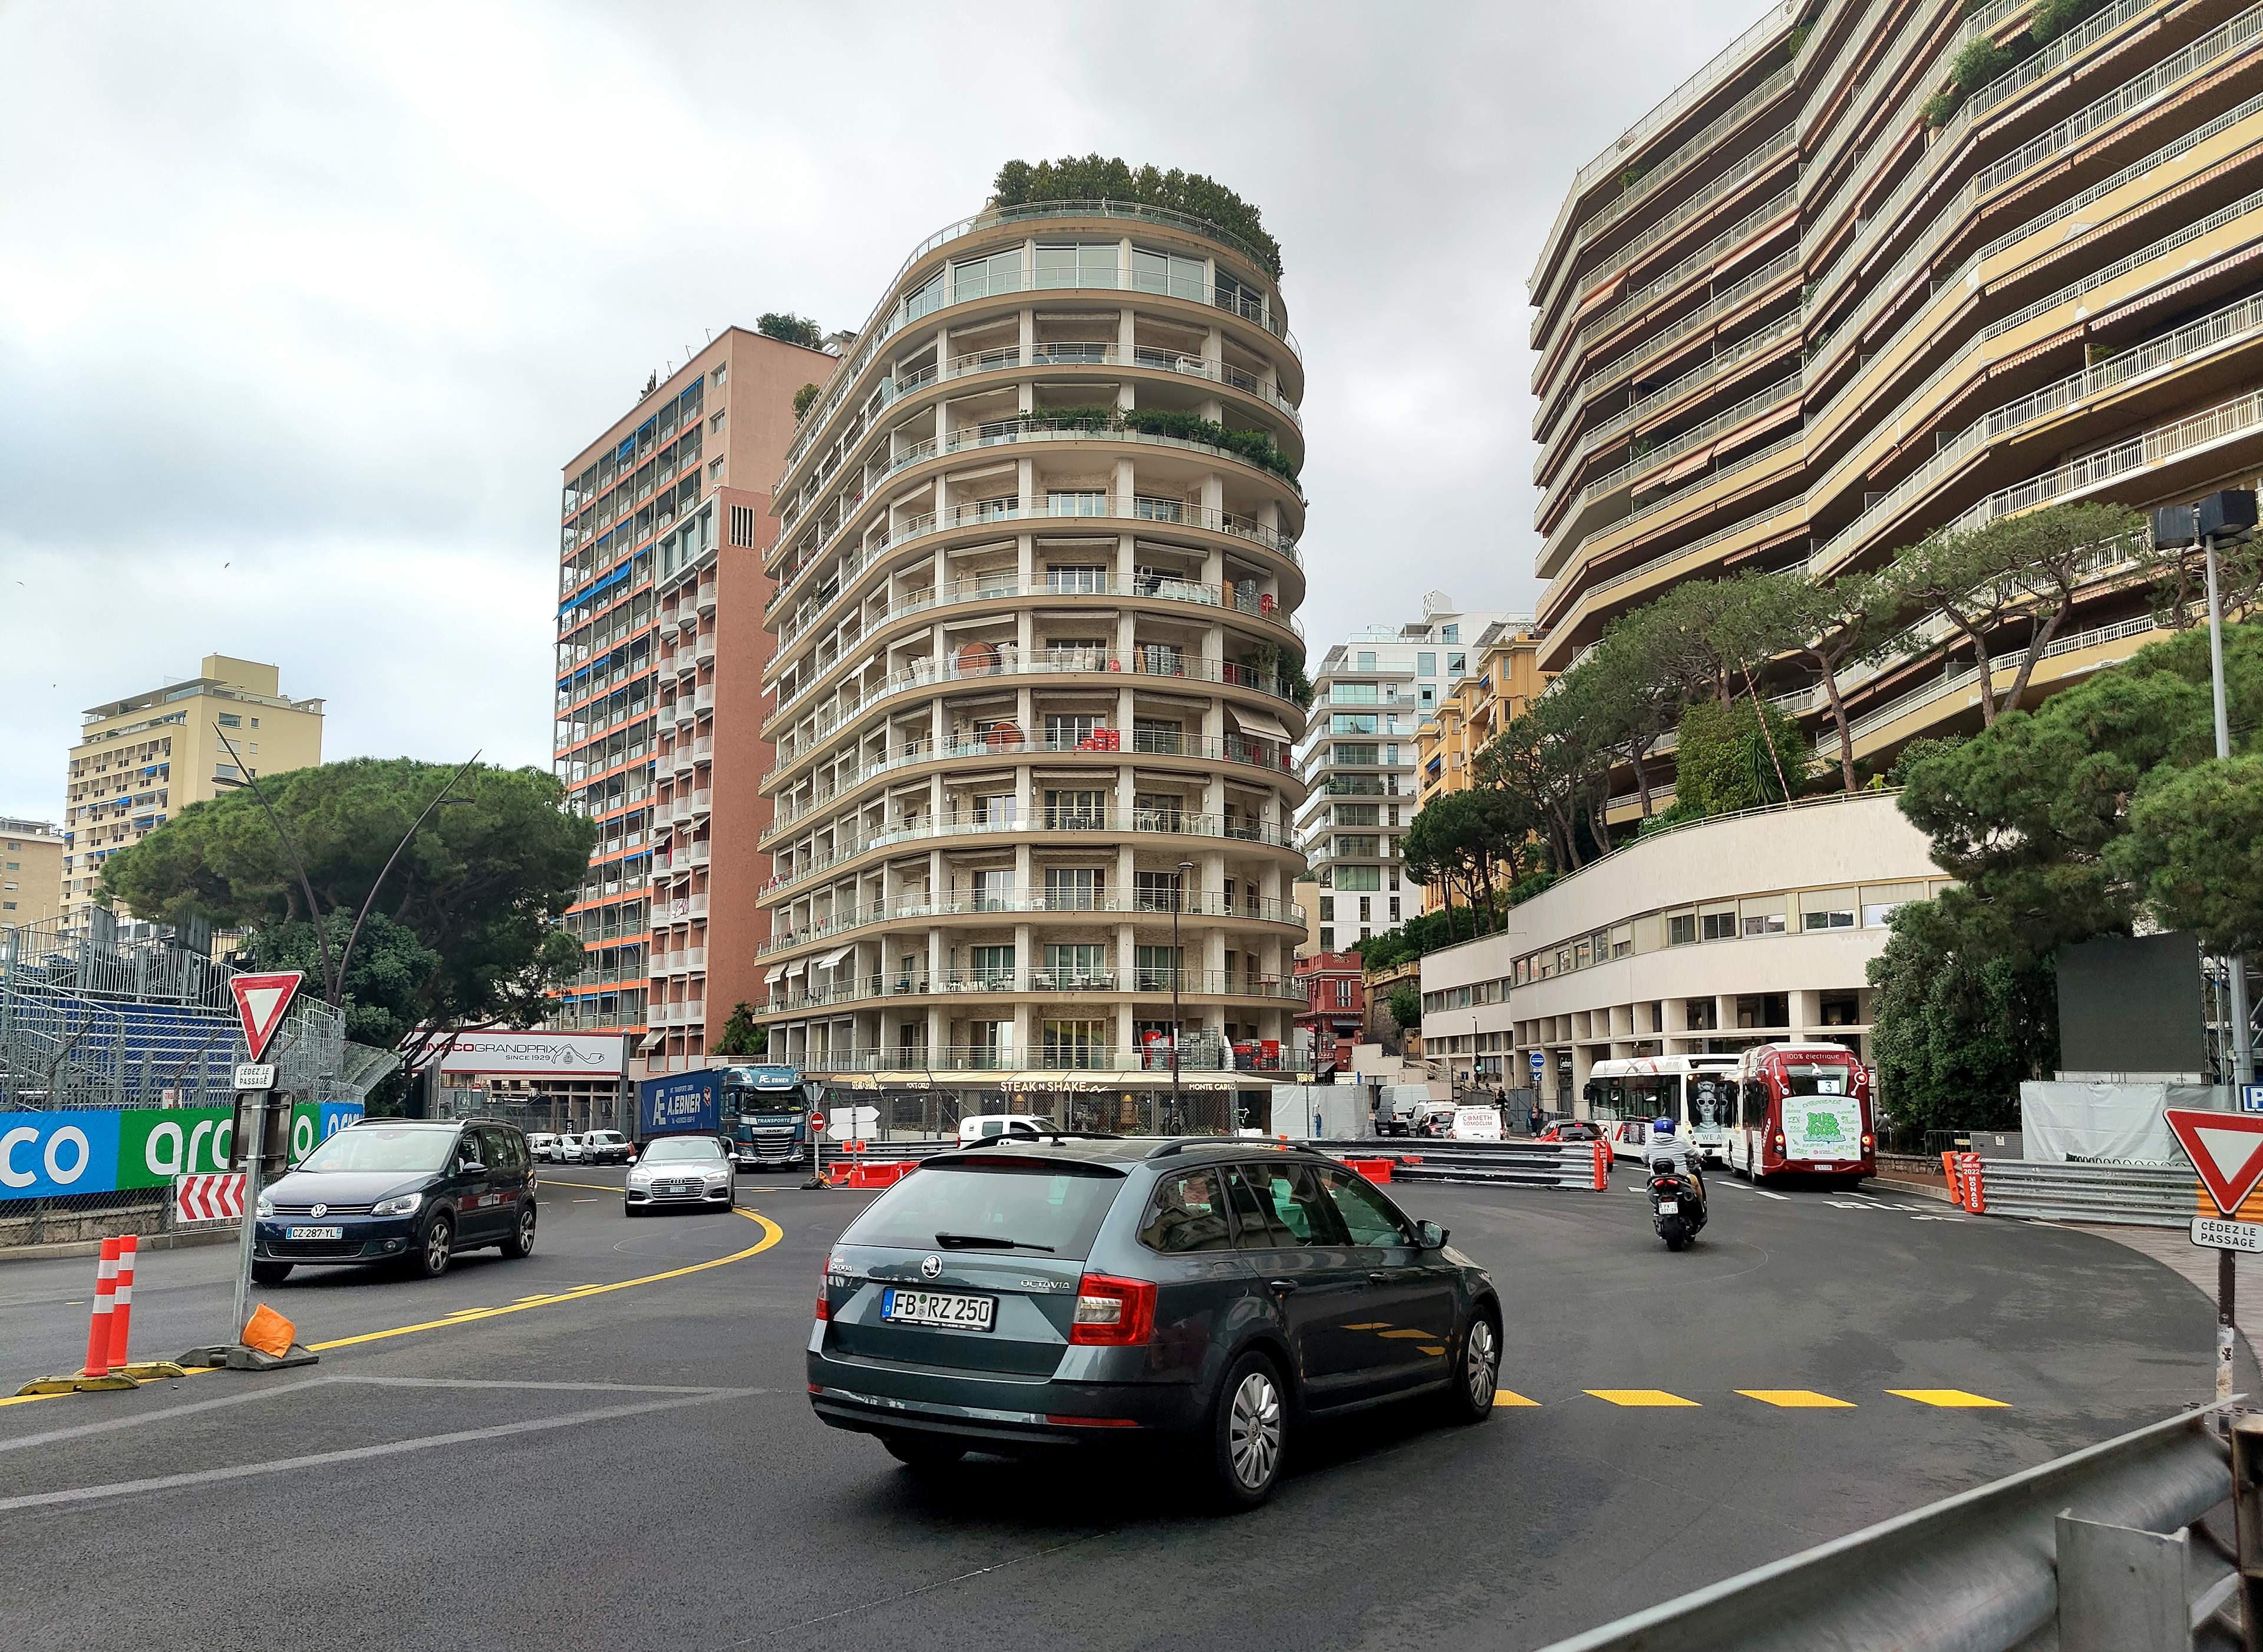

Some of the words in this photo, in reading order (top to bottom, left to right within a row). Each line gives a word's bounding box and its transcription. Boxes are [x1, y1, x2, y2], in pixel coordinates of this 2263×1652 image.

[1806, 1052, 1839, 1061] électrique
[240, 1077, 268, 1085] PASSAGE
[1000, 1081, 1037, 1092] STEAK
[1047, 1081, 1087, 1092] SHAKE
[1825, 1081, 1832, 1092] 3
[1968, 1176, 1978, 1208] MONACO
[293, 1229, 335, 1237] CZ-287-YL
[2201, 1221, 2239, 1235] CÉDEZ
[2243, 1227, 2257, 1237] LE
[2201, 1233, 2256, 1248] PASSAGE
[1020, 1280, 1070, 1290] OCTAVIA
[893, 1293, 916, 1315] FB
[928, 1297, 952, 1319] RZ
[955, 1299, 990, 1322] 250
